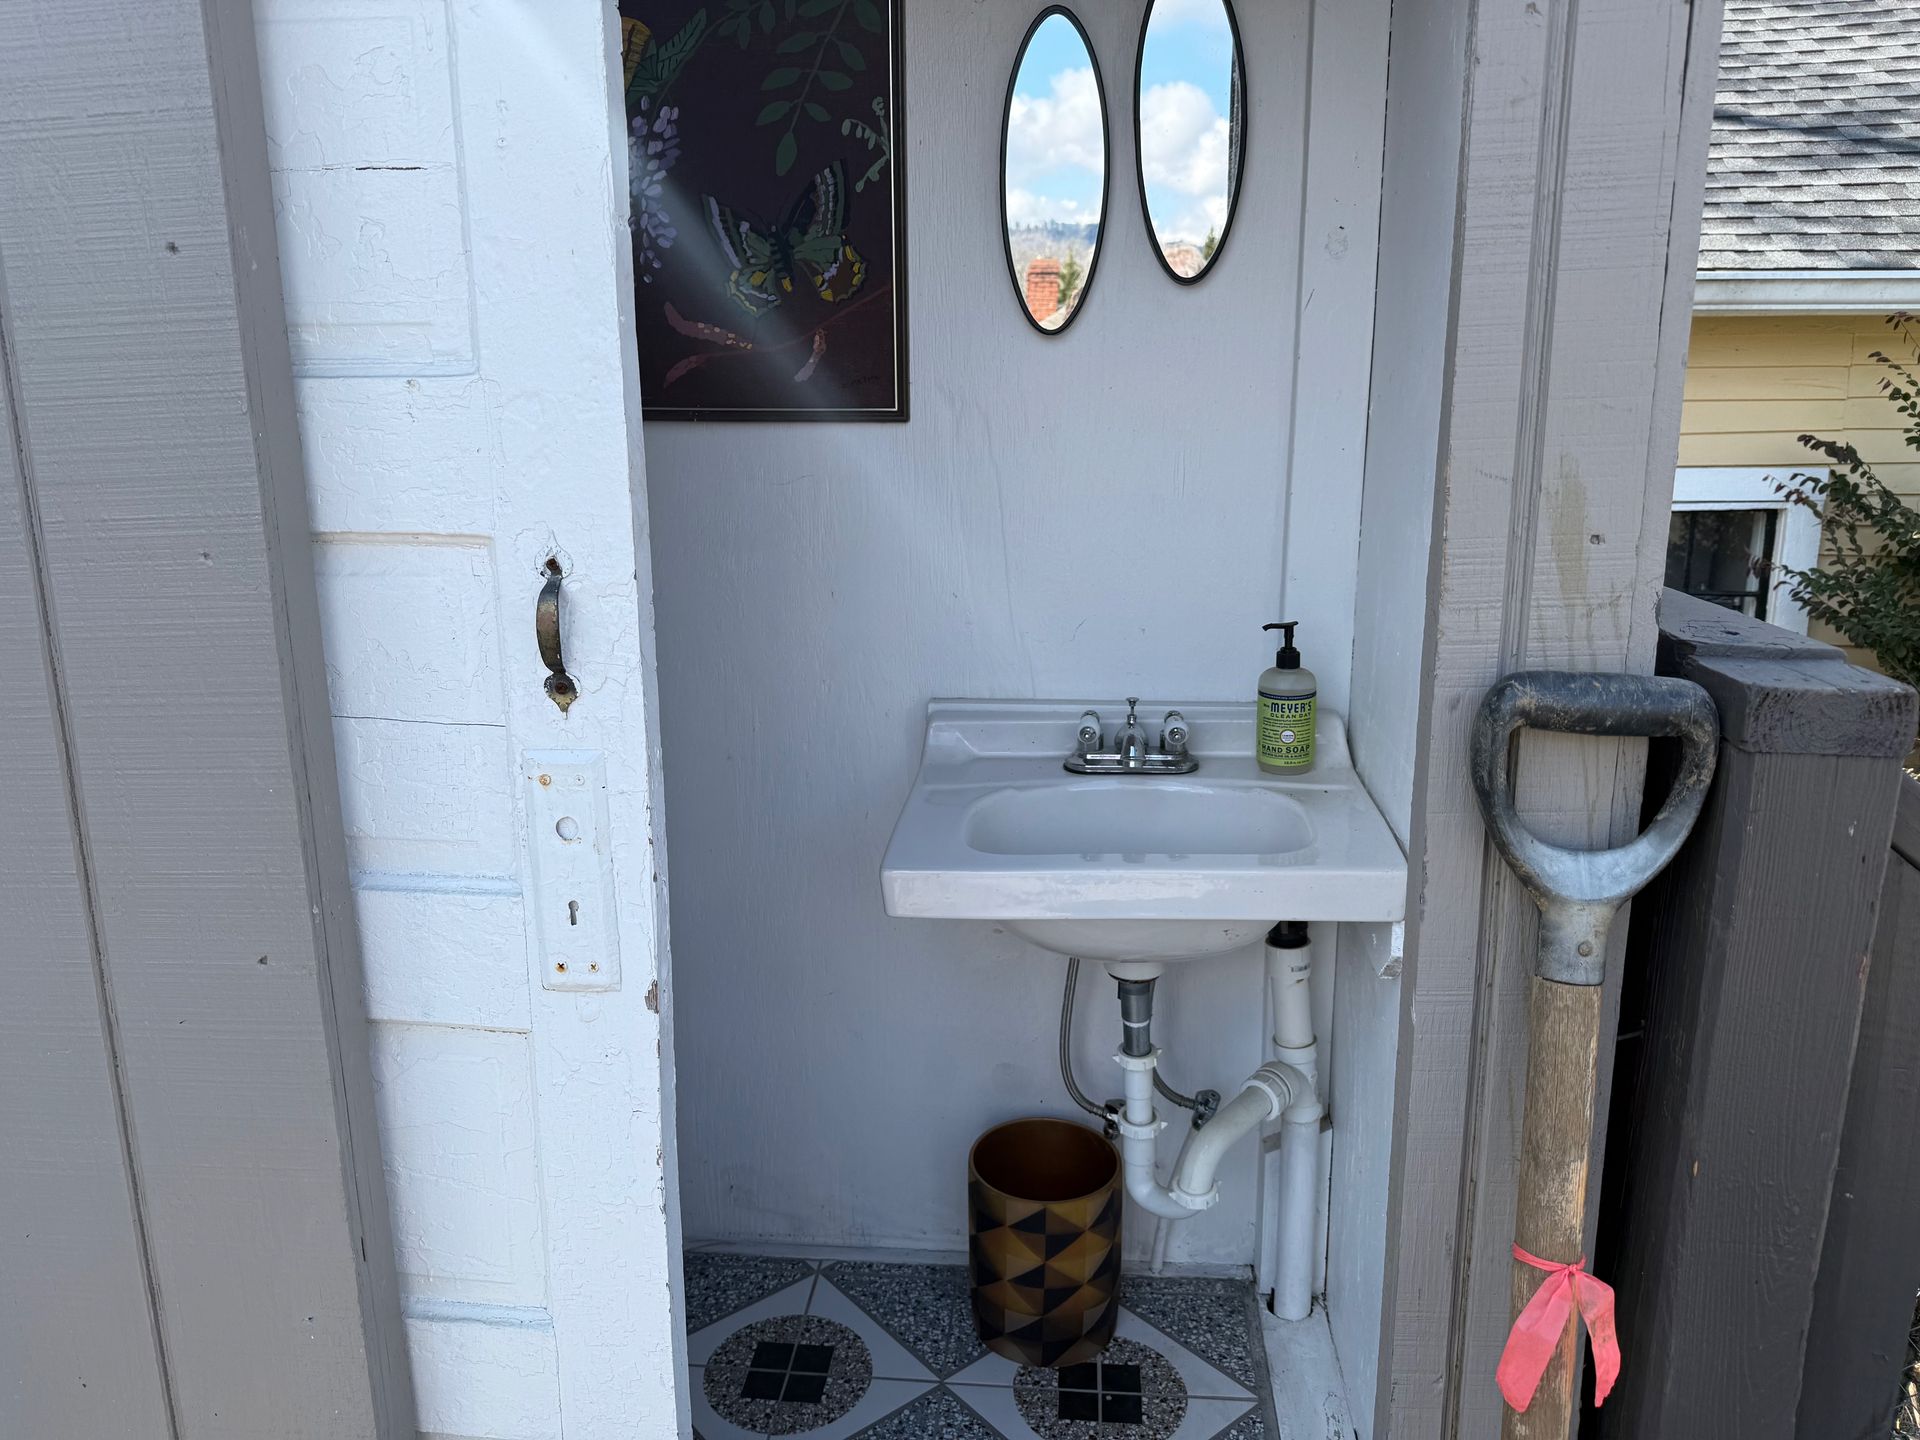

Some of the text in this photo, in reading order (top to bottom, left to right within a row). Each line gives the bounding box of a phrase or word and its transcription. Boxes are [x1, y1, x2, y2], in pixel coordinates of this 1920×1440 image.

[1271, 701, 1312, 713] MEYER'S
[1262, 744, 1310, 754] HAND SOAP
